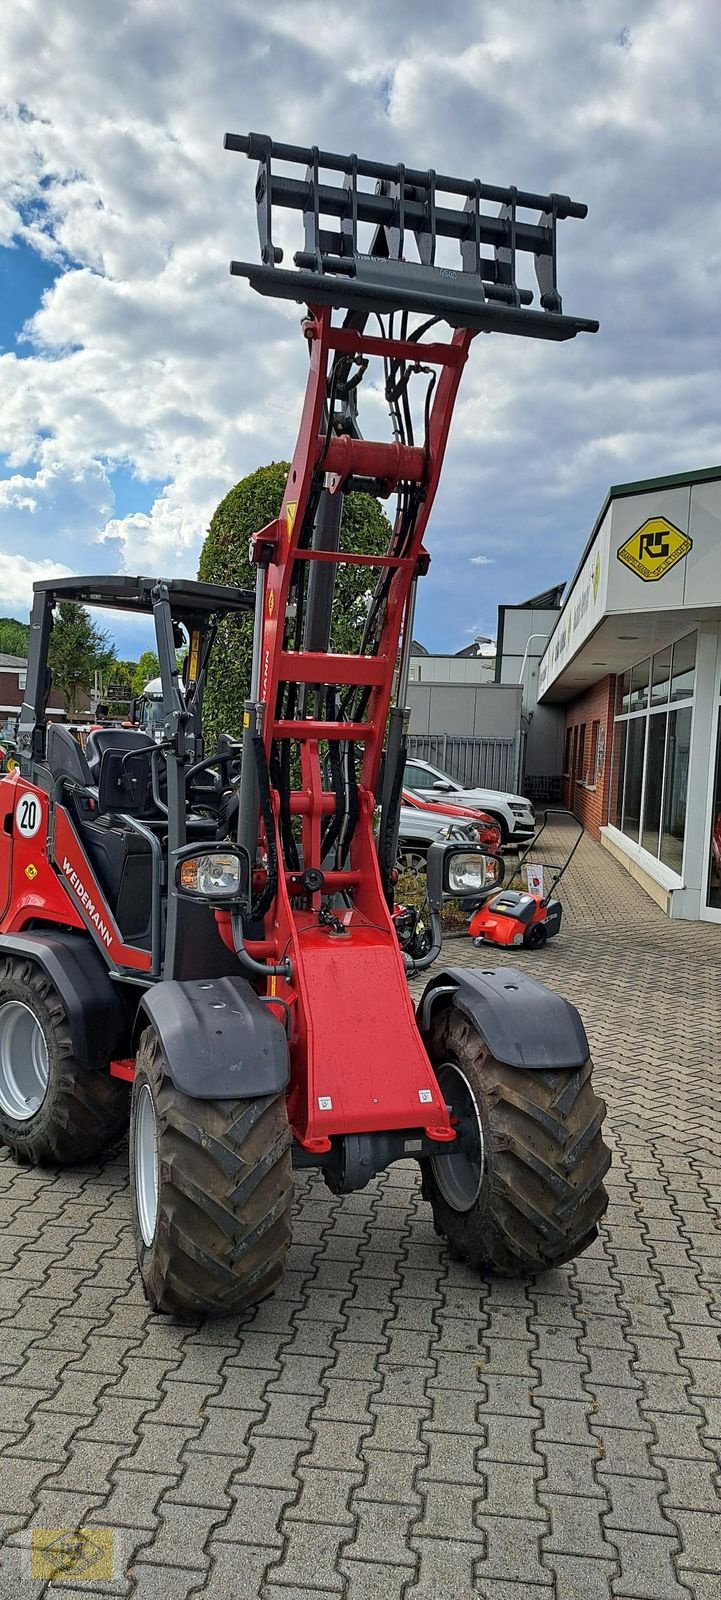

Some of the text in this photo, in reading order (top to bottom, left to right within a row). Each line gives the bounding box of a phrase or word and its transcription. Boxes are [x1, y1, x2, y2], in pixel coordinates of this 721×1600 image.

[639, 531, 670, 560] RS
[20, 800, 37, 830] 20
[62, 856, 113, 947] WEIDEMANN
